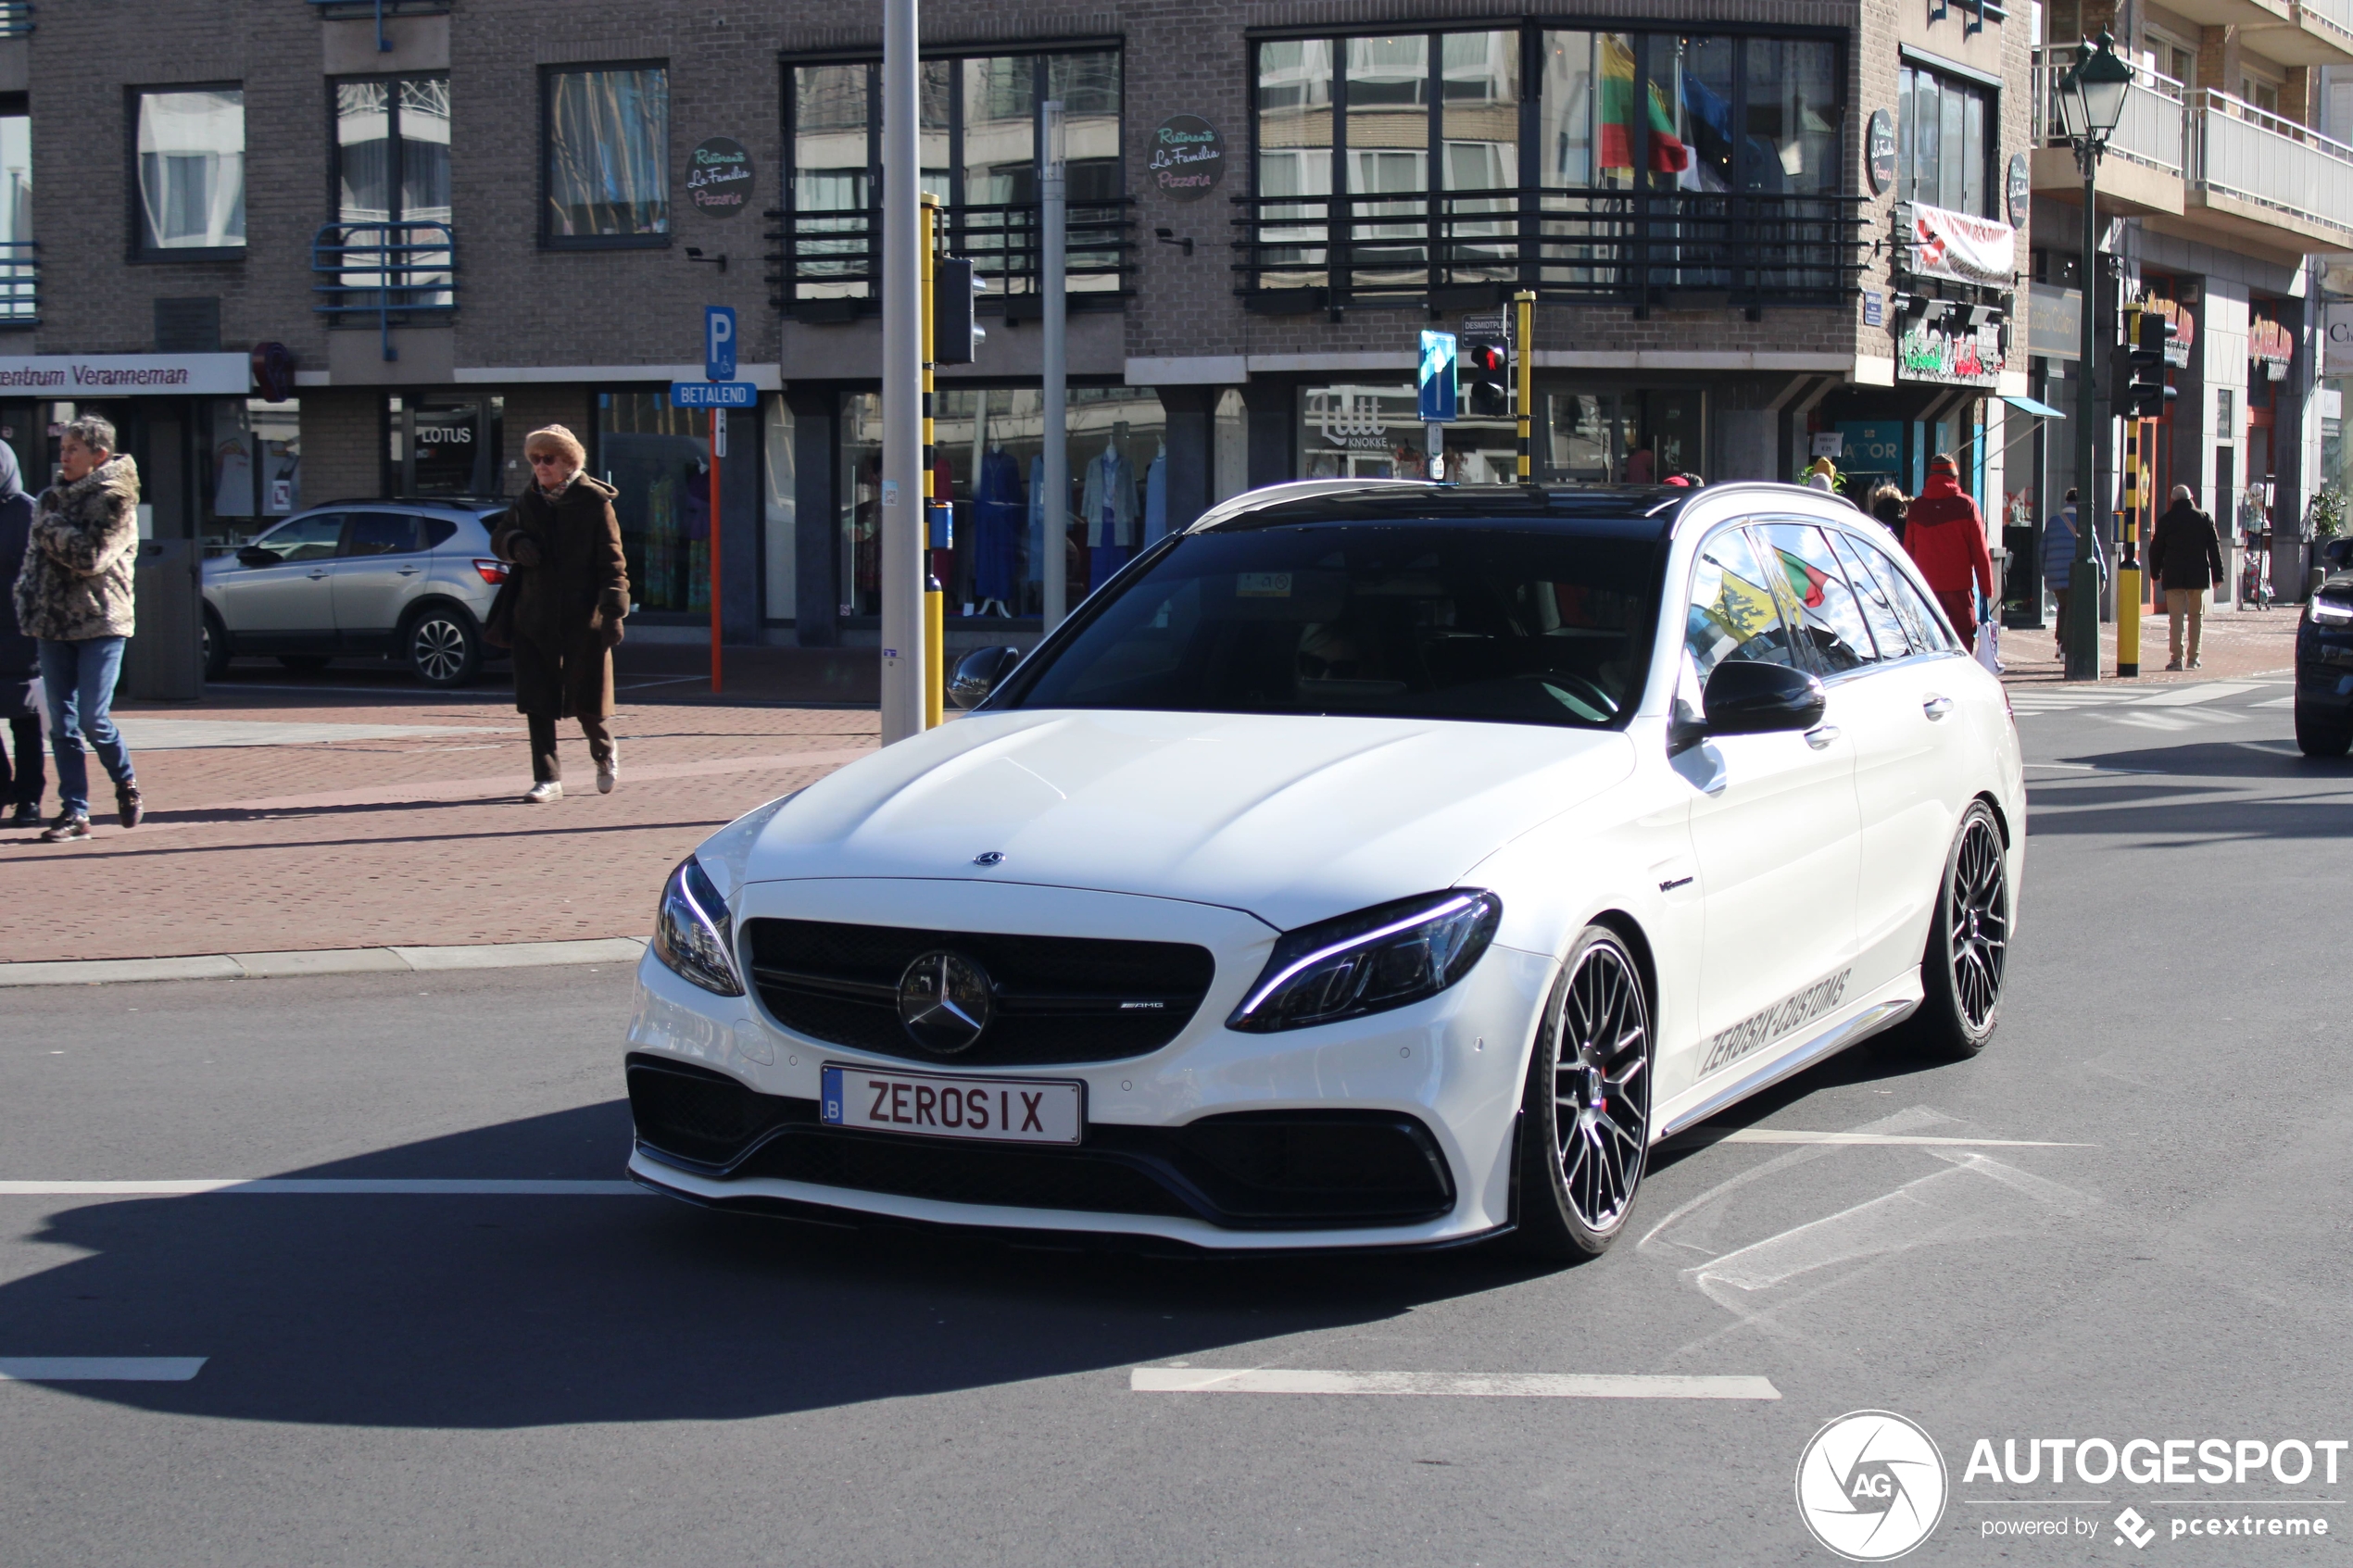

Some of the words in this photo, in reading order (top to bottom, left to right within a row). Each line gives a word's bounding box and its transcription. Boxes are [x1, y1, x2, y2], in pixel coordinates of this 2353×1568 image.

[1157, 128, 1214, 144] Ristorante
[694, 149, 746, 164] Ristorante
[1150, 149, 1173, 169] La
[1171, 145, 1220, 164] Familia
[687, 169, 709, 188] La
[706, 166, 750, 183] Familia
[1157, 171, 1211, 189] Pizzeria
[1465, 320, 1512, 330] DESMIDTPLEN
[711, 313, 732, 363] P
[72, 365, 189, 385] Veranneman
[681, 387, 747, 403] BETALEND
[1310, 393, 1387, 445] Lutt
[422, 428, 472, 443] LOTUS
[1349, 437, 1388, 447] KNOKKE
[1698, 967, 1852, 1078] ZEROSIX-CUSTOMS
[827, 1100, 839, 1119] B
